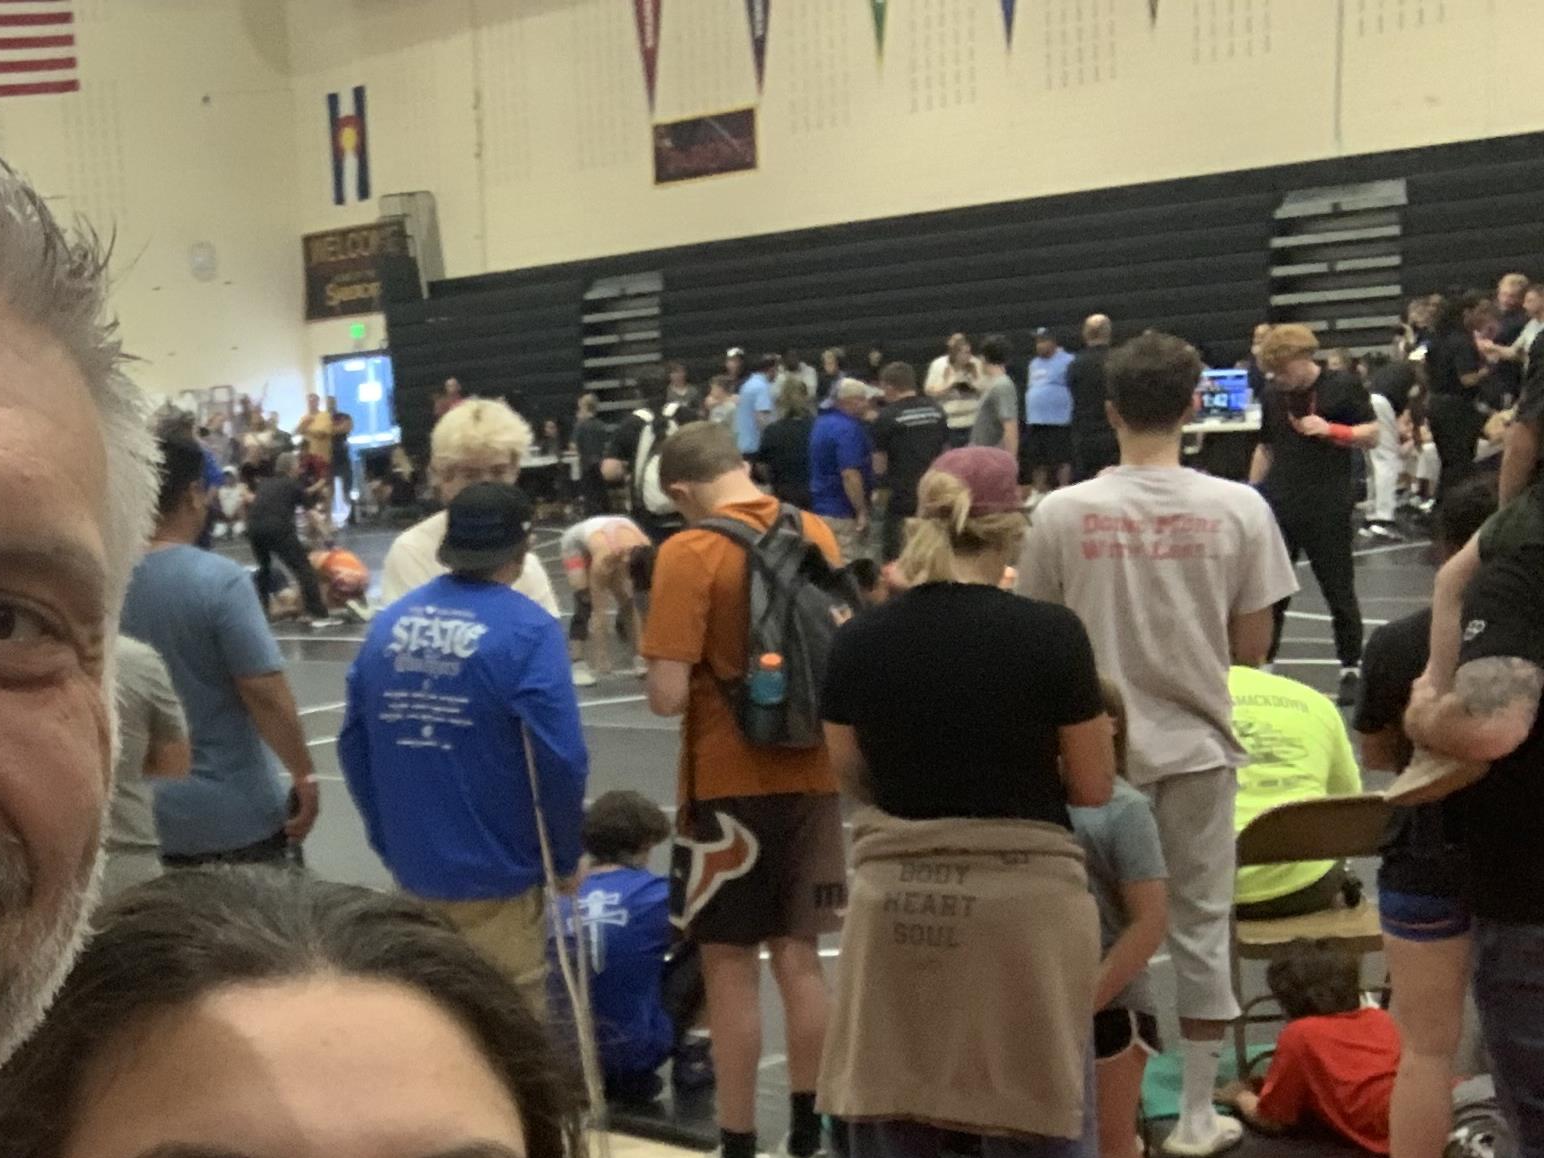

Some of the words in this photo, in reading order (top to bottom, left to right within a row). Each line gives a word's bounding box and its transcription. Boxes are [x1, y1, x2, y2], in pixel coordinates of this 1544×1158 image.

[899, 862, 971, 885] BODY
[883, 892, 977, 917] HEART
[893, 921, 960, 948] SOUL
